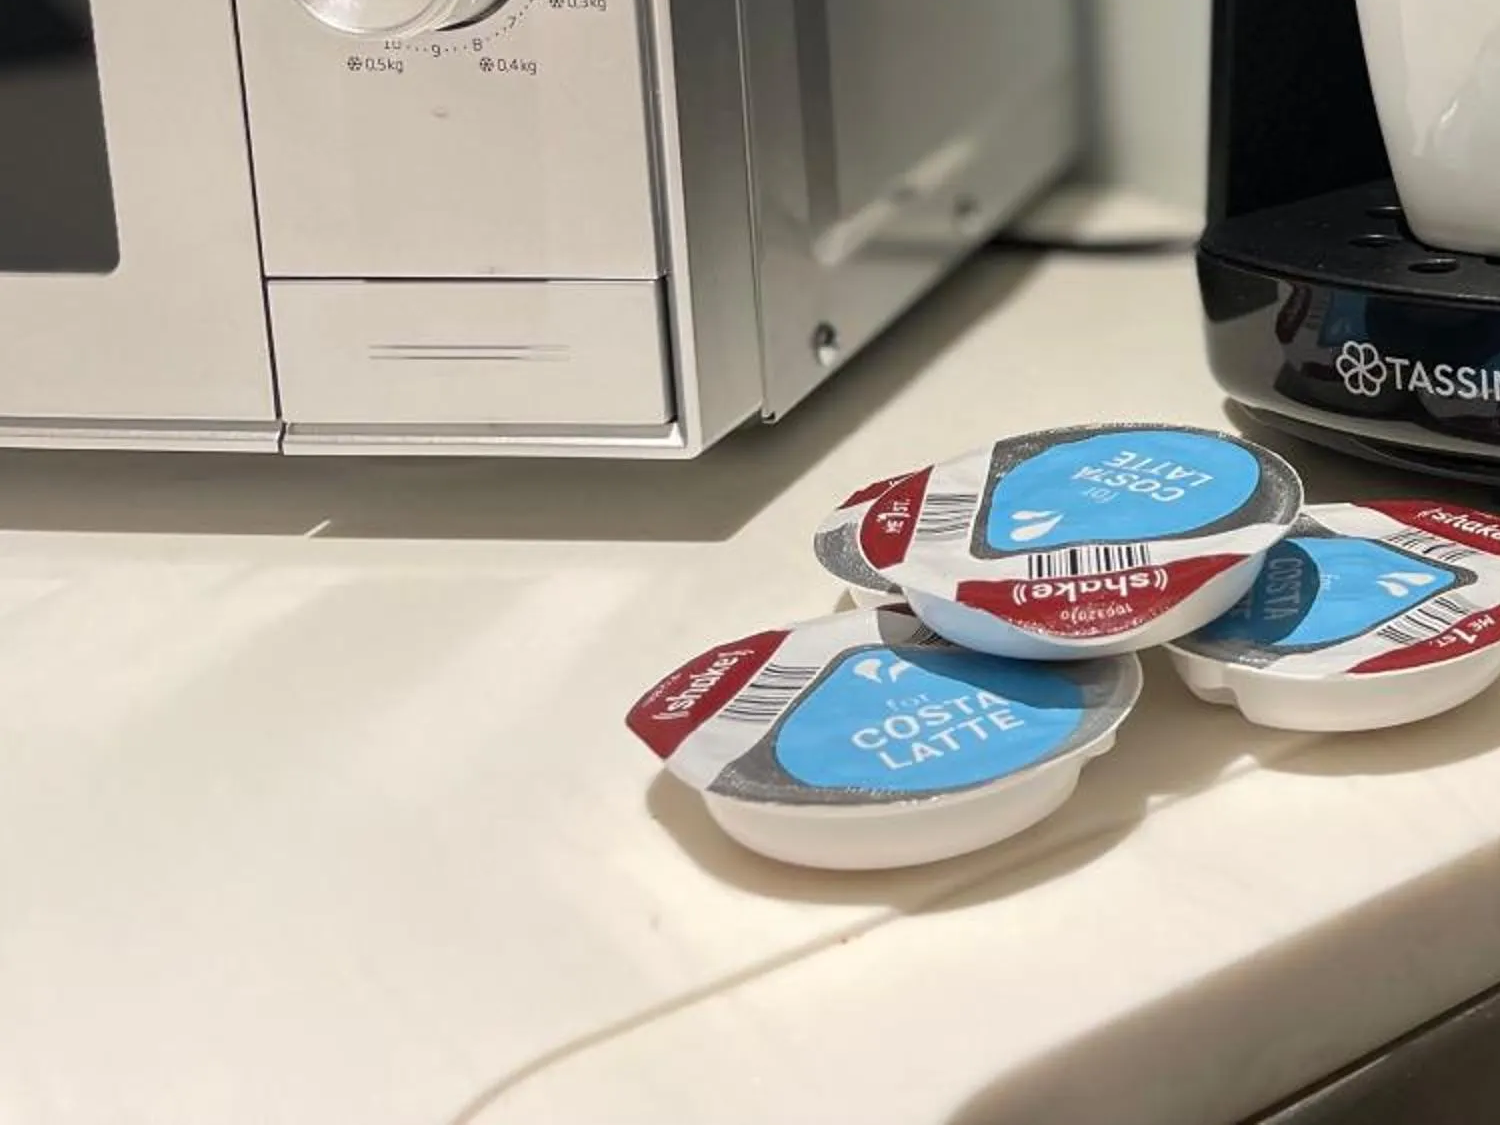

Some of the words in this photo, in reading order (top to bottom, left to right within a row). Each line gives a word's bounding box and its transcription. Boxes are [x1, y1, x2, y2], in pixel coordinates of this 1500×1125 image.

[507, 15, 518, 30] 7
[431, 43, 442, 58] 9
[472, 37, 484, 52] 8
[364, 58, 405, 75] 0.5kg
[496, 58, 538, 76] 0.4kg
[1102, 450, 1216, 488] LATTE
[1071, 465, 1186, 503] COSTA
[1263, 557, 1304, 621] COSTA
[886, 692, 930, 713] for
[851, 689, 1011, 750] COSTA
[877, 708, 1025, 771] LATTE
